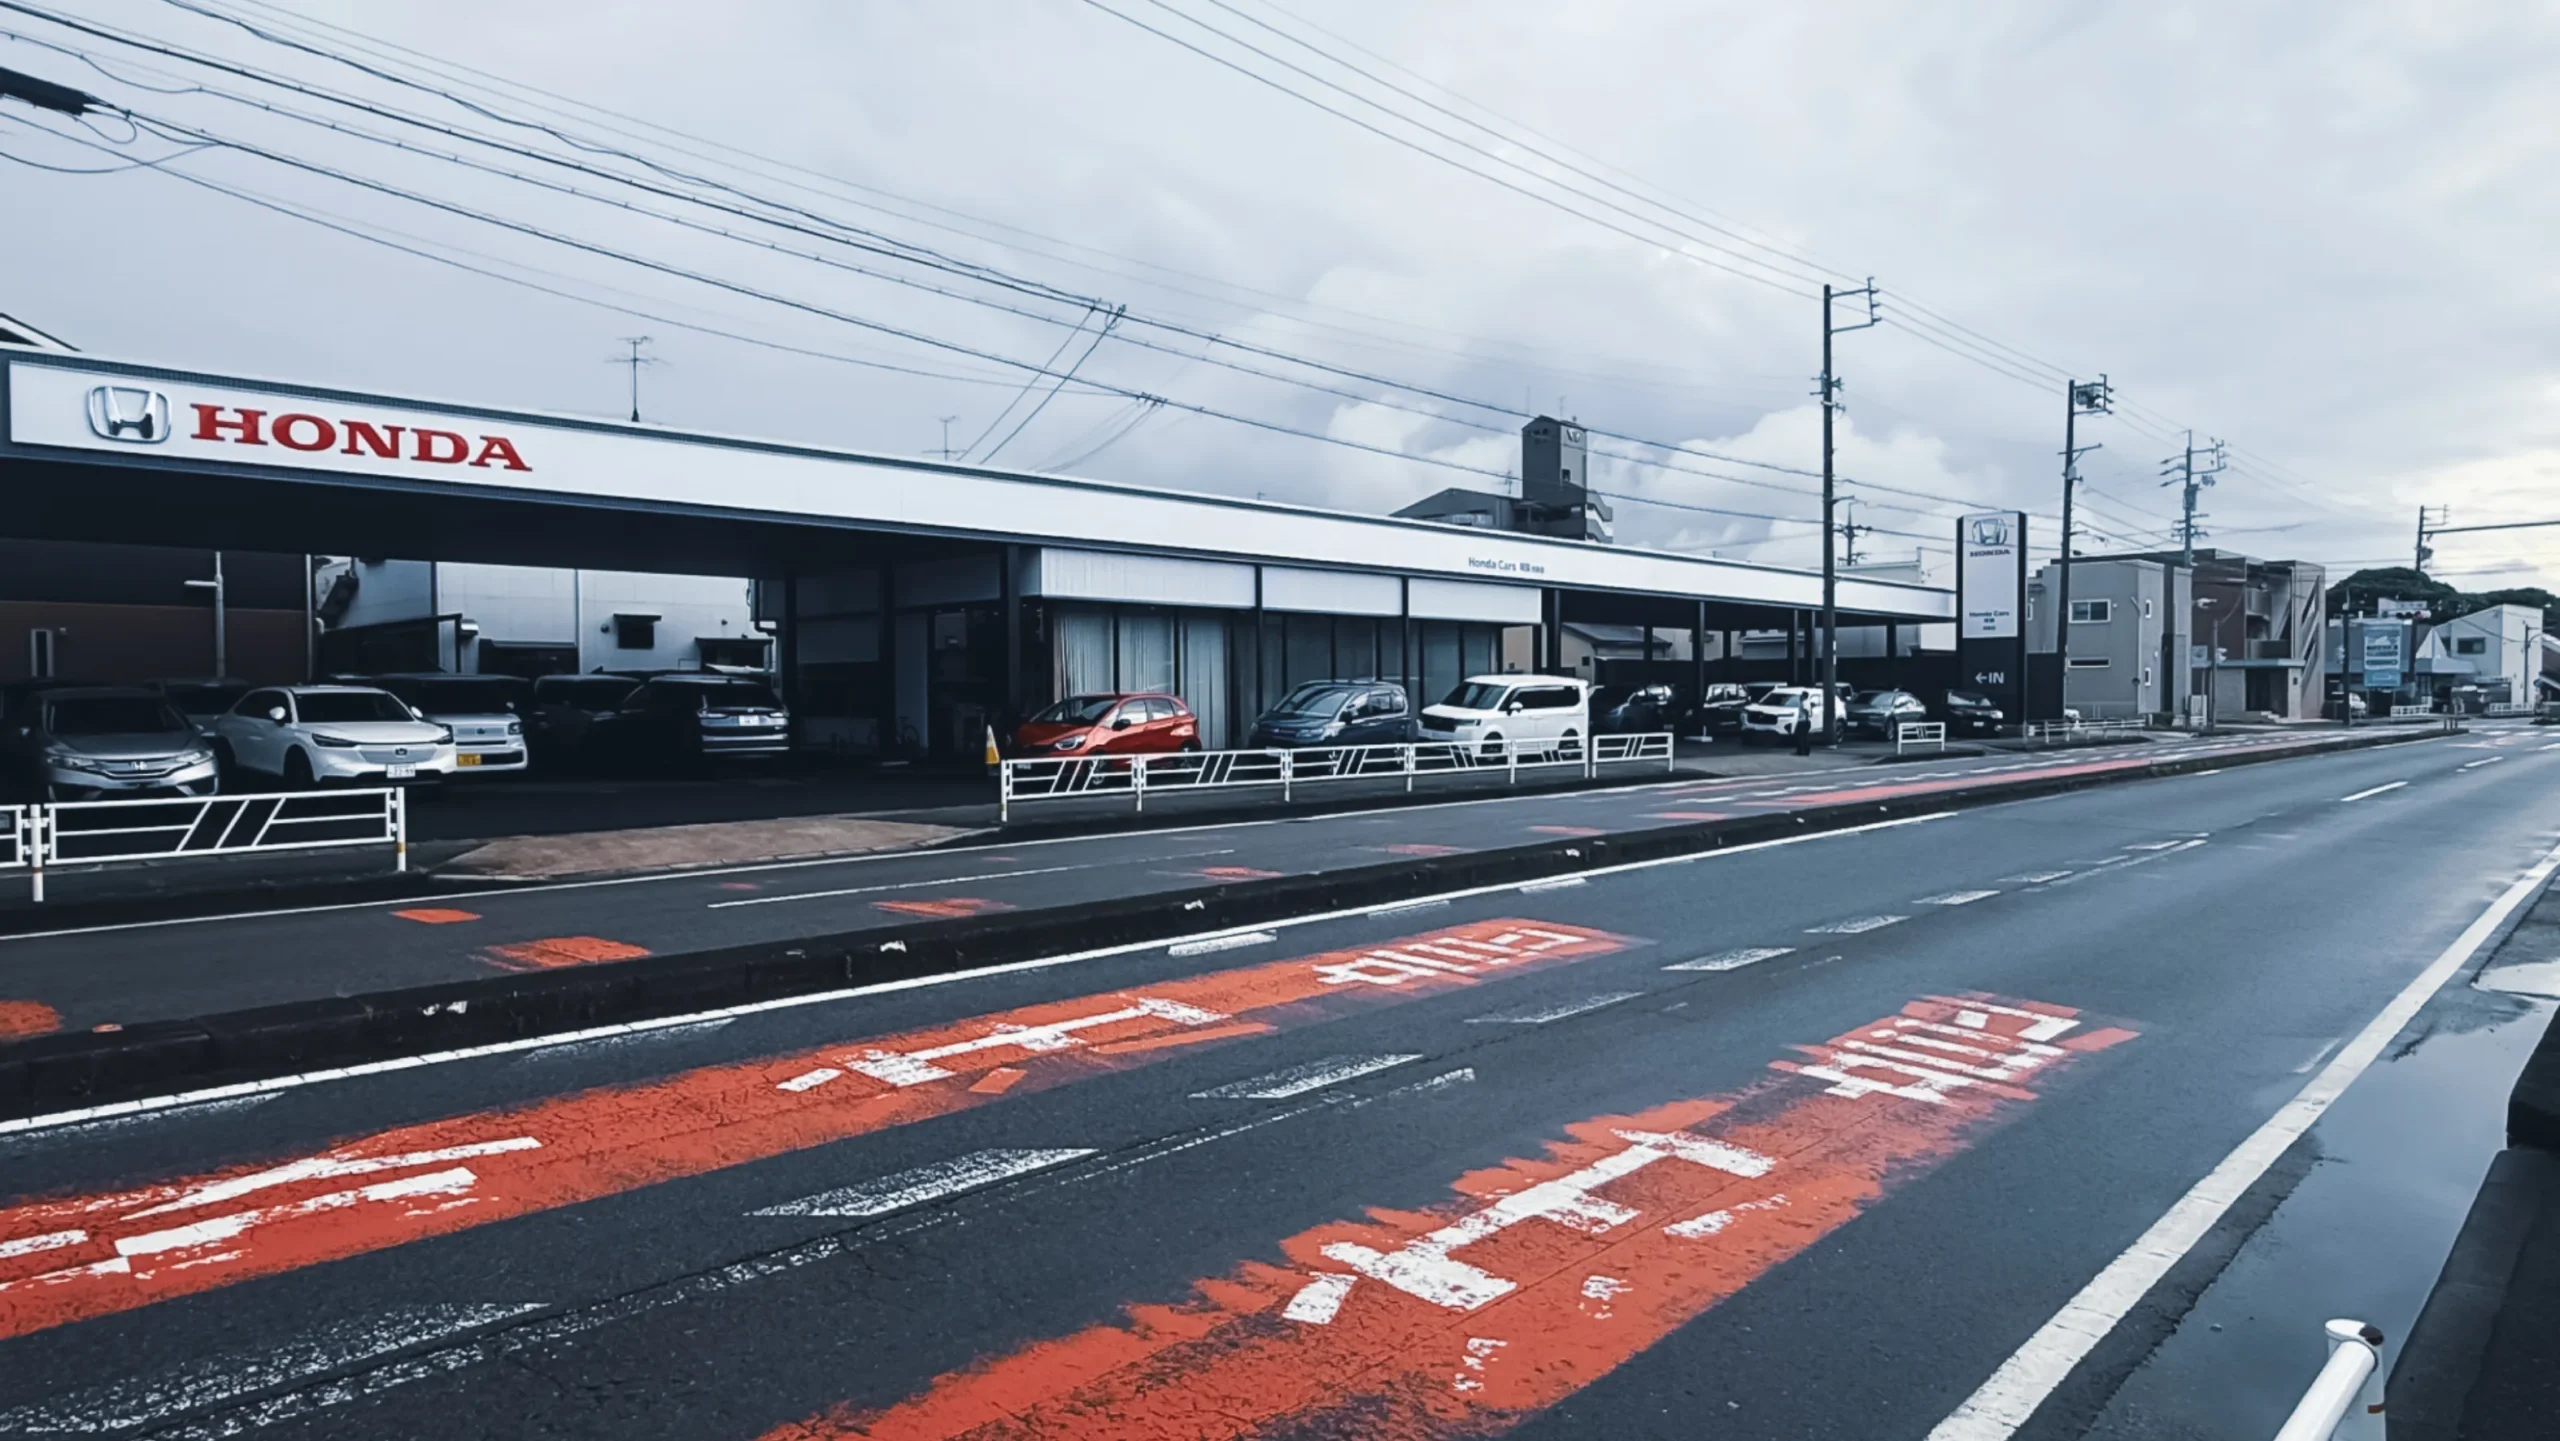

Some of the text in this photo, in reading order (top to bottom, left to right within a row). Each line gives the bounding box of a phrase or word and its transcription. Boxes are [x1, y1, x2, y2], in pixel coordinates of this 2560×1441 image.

[190, 402, 532, 472] HONDA
[1969, 549, 2011, 558] HONDA
[1468, 557, 1496, 569] Honda
[1498, 560, 1517, 571] Cars
[1988, 671, 2004, 684] IN
